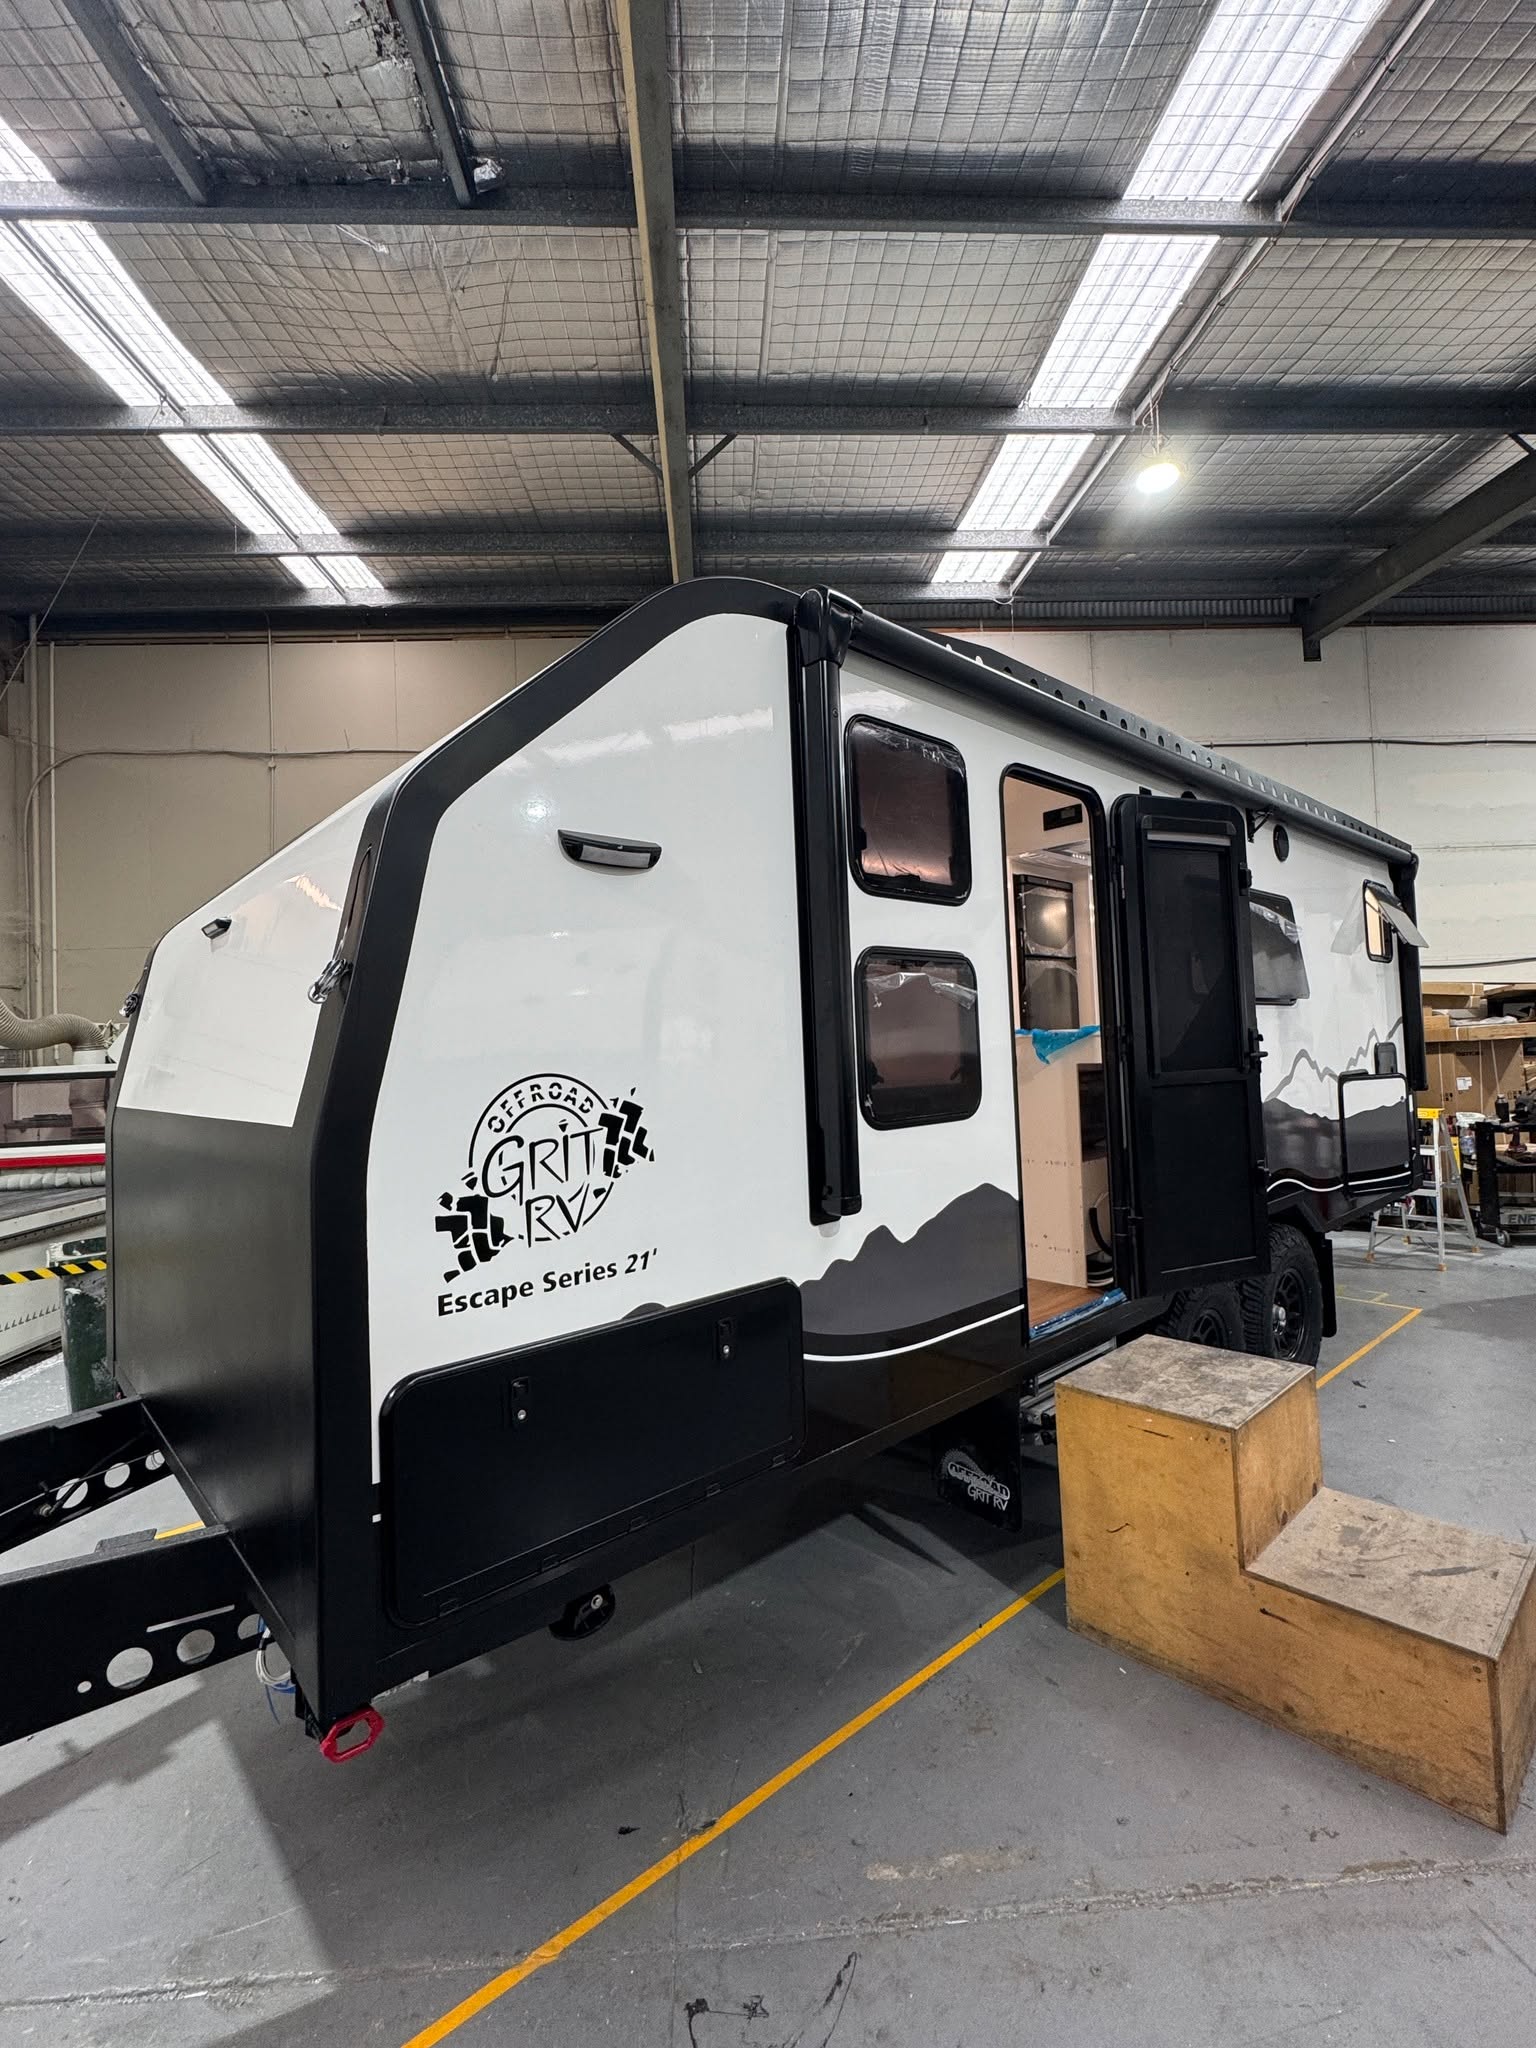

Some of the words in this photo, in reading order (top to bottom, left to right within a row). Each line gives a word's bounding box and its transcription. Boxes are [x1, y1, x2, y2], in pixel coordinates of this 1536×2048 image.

[487, 1082, 594, 1134] OFFROAD
[482, 1119, 604, 1206] GRIT
[525, 1183, 590, 1248] RV
[437, 1280, 534, 1317] Escape
[542, 1261, 618, 1293] Series
[624, 1247, 658, 1274] 21'
[948, 1462, 1010, 1500] OFFROAD
[967, 1484, 992, 1504] GRIT
[993, 1495, 1009, 1511] RV
